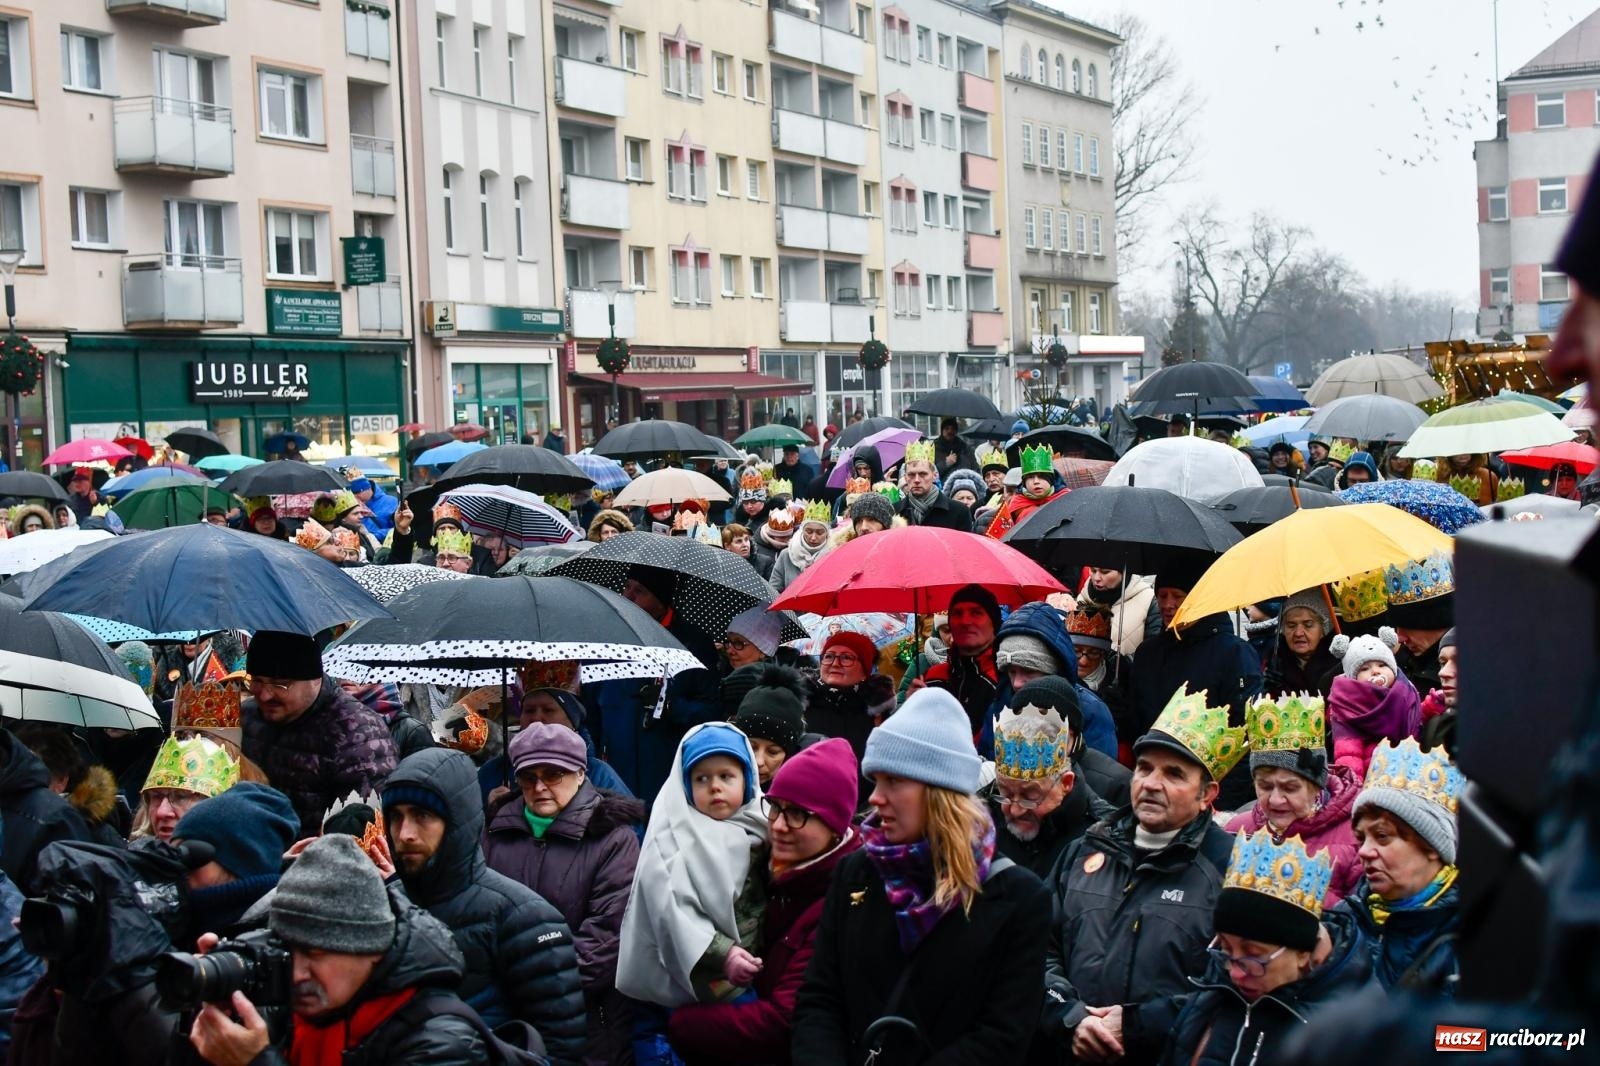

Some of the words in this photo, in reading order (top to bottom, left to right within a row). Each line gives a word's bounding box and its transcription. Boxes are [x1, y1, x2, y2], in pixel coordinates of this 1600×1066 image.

[195, 363, 308, 385] JUBILER
[843, 363, 863, 383] empik
[224, 389, 243, 398] 1989
[351, 416, 394, 432] CASIO
